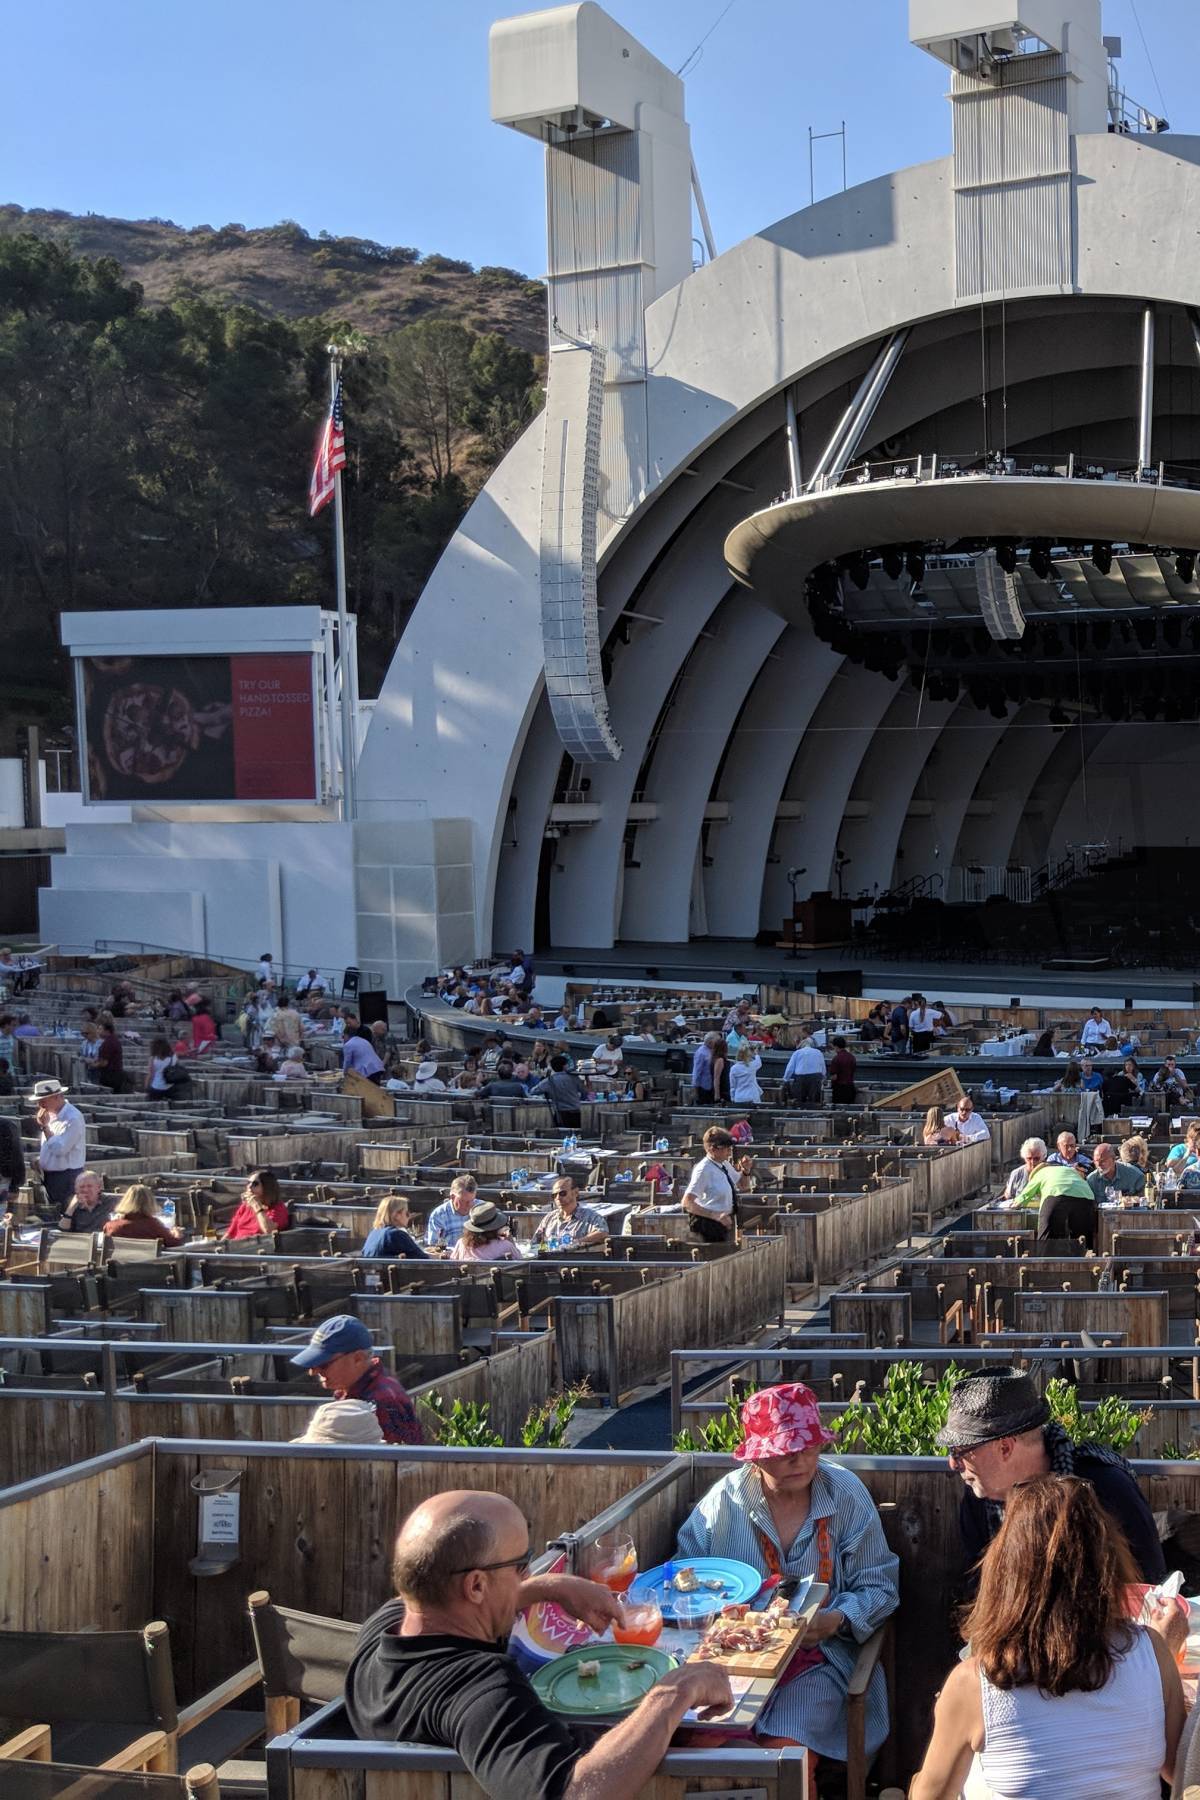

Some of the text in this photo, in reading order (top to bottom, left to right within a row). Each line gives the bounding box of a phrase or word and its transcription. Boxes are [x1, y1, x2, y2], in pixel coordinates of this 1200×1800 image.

[239, 680, 281, 690] TRY OUR
[239, 707, 273, 718] PIZZA!
